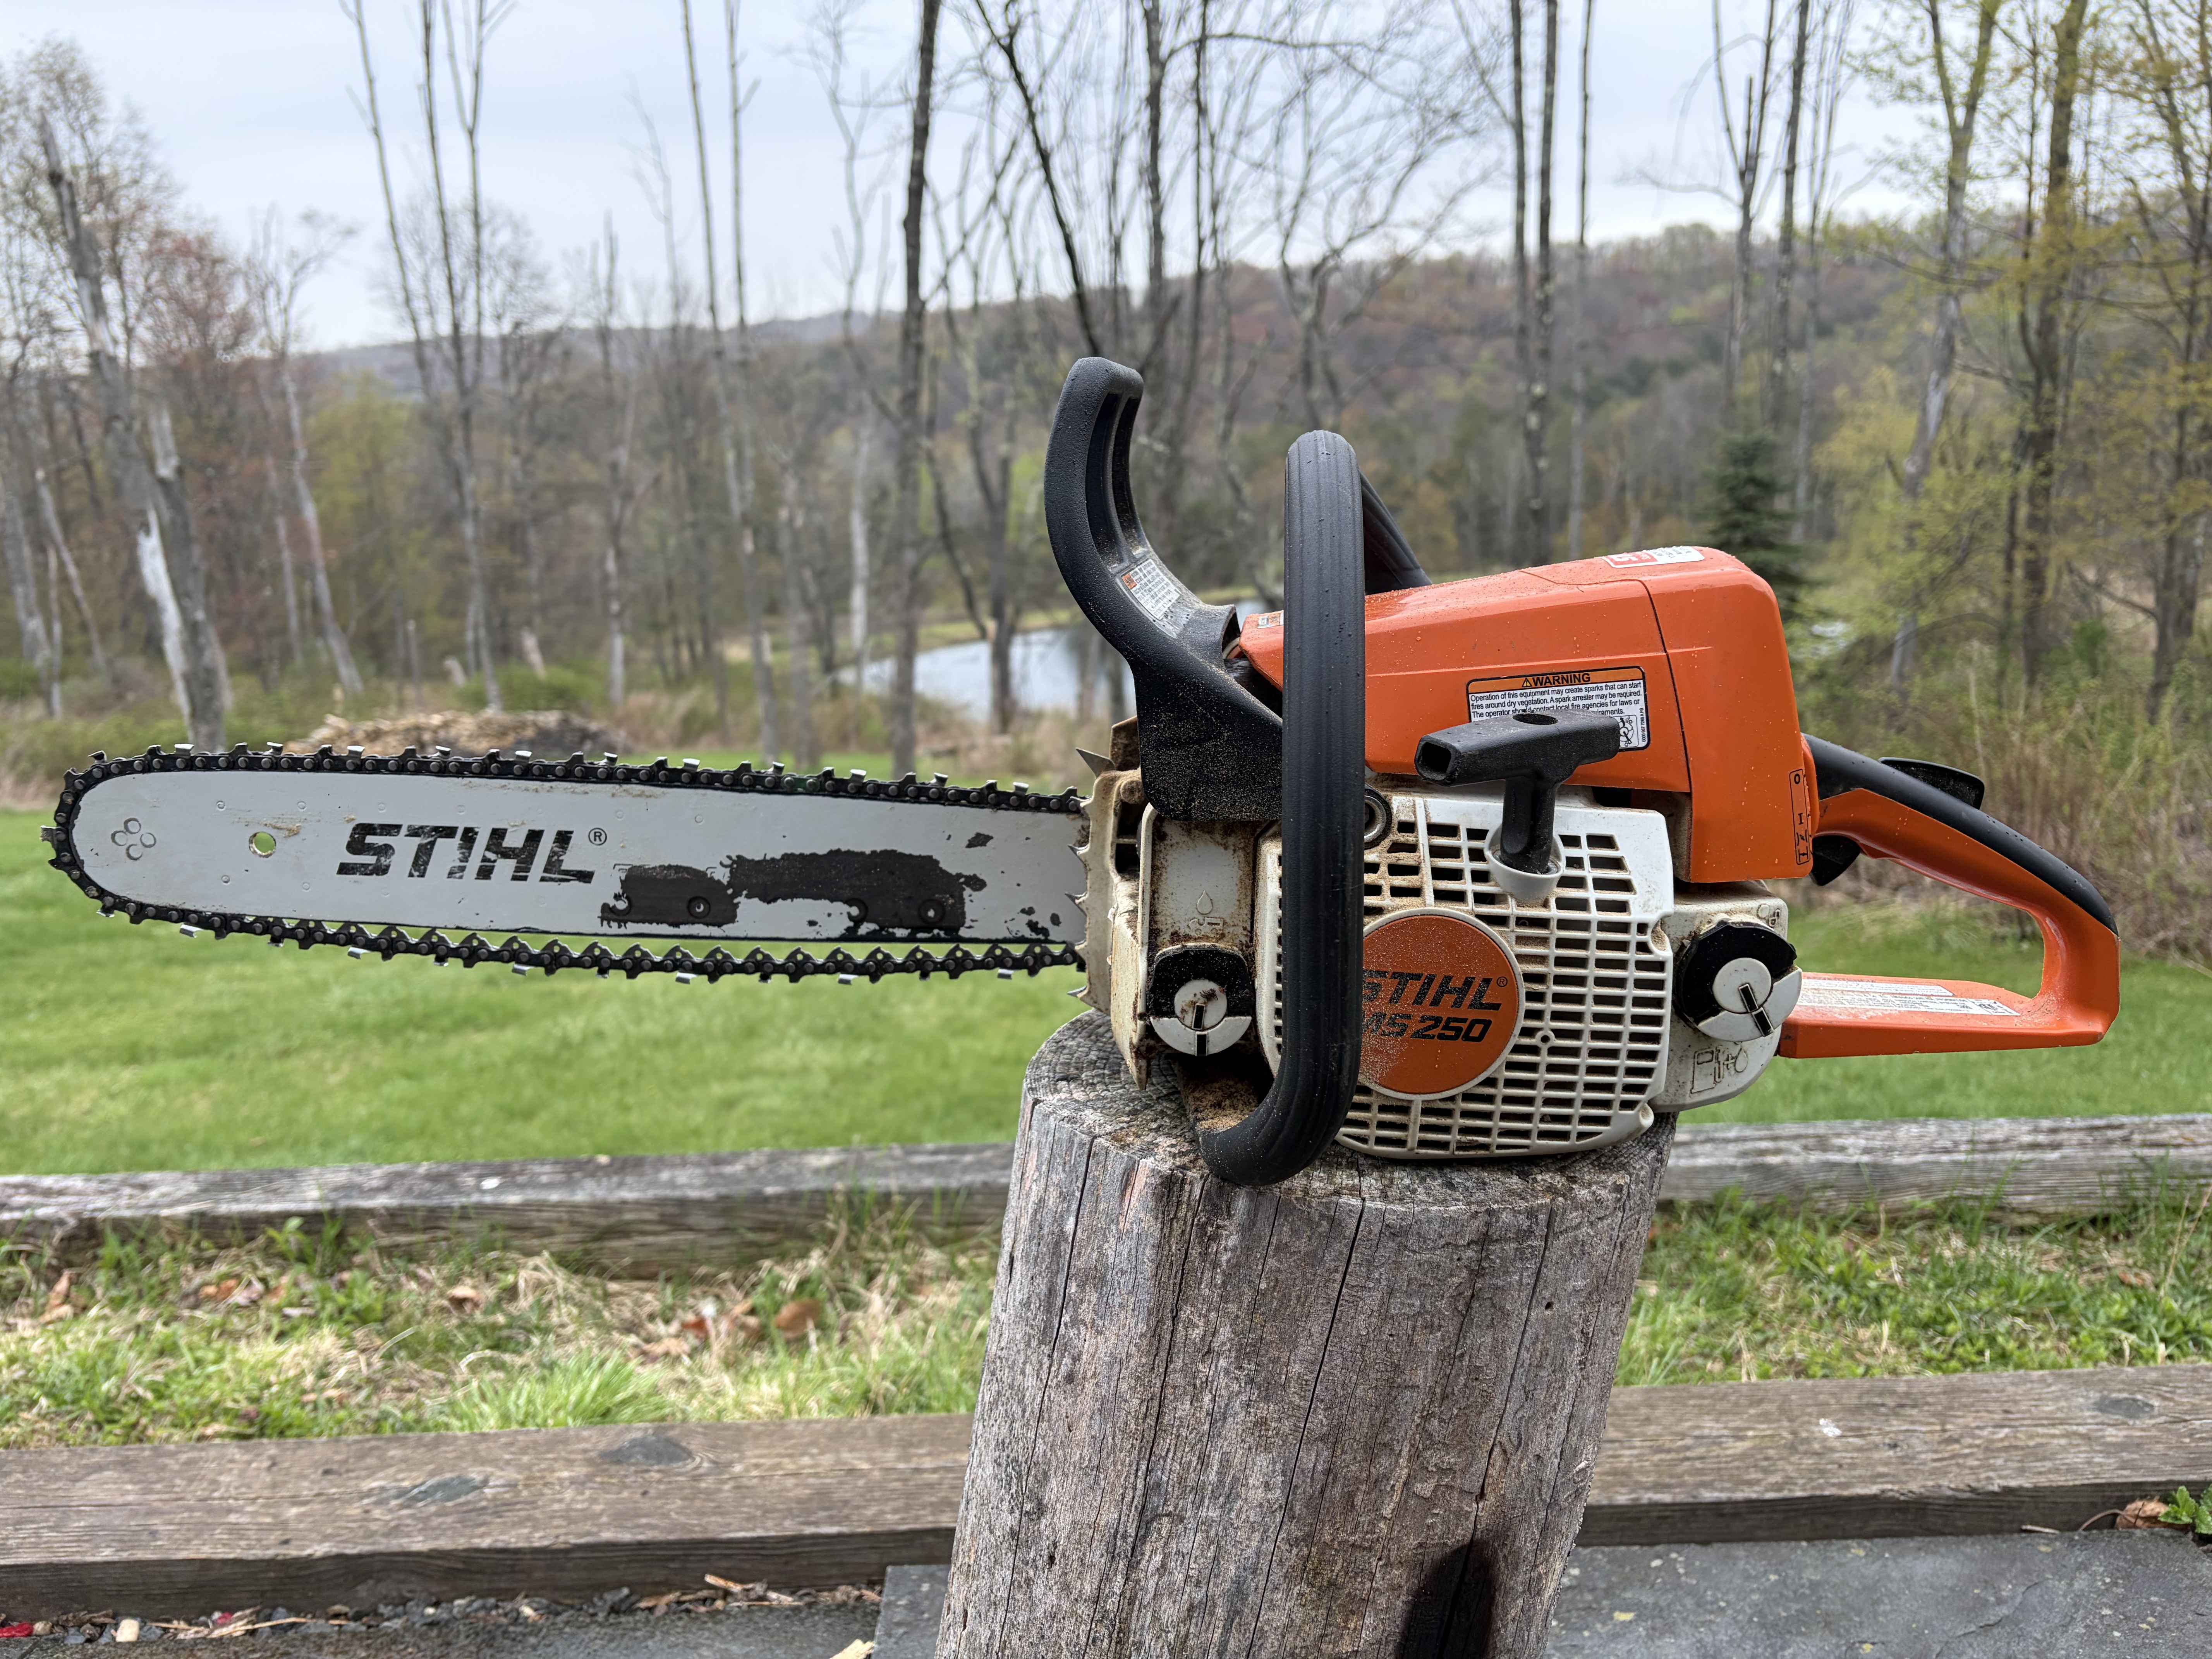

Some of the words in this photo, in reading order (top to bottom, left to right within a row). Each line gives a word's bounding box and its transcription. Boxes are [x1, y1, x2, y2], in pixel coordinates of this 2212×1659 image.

[1532, 673, 1591, 687] WARNING
[1471, 692, 1499, 702] Operation
[1519, 689, 1550, 698] equipment
[1584, 684, 1603, 693] sparks
[1604, 683, 1616, 691] that
[1485, 701, 1506, 709] around
[1507, 700, 1516, 708] dry
[1518, 697, 1549, 707] vegetation.
[1555, 696, 1571, 704] spark
[1617, 690, 1642, 698] required.
[1485, 709, 1510, 718] operator
[1582, 701, 1608, 710] agencies
[1410, 1015, 1492, 1042] 250
